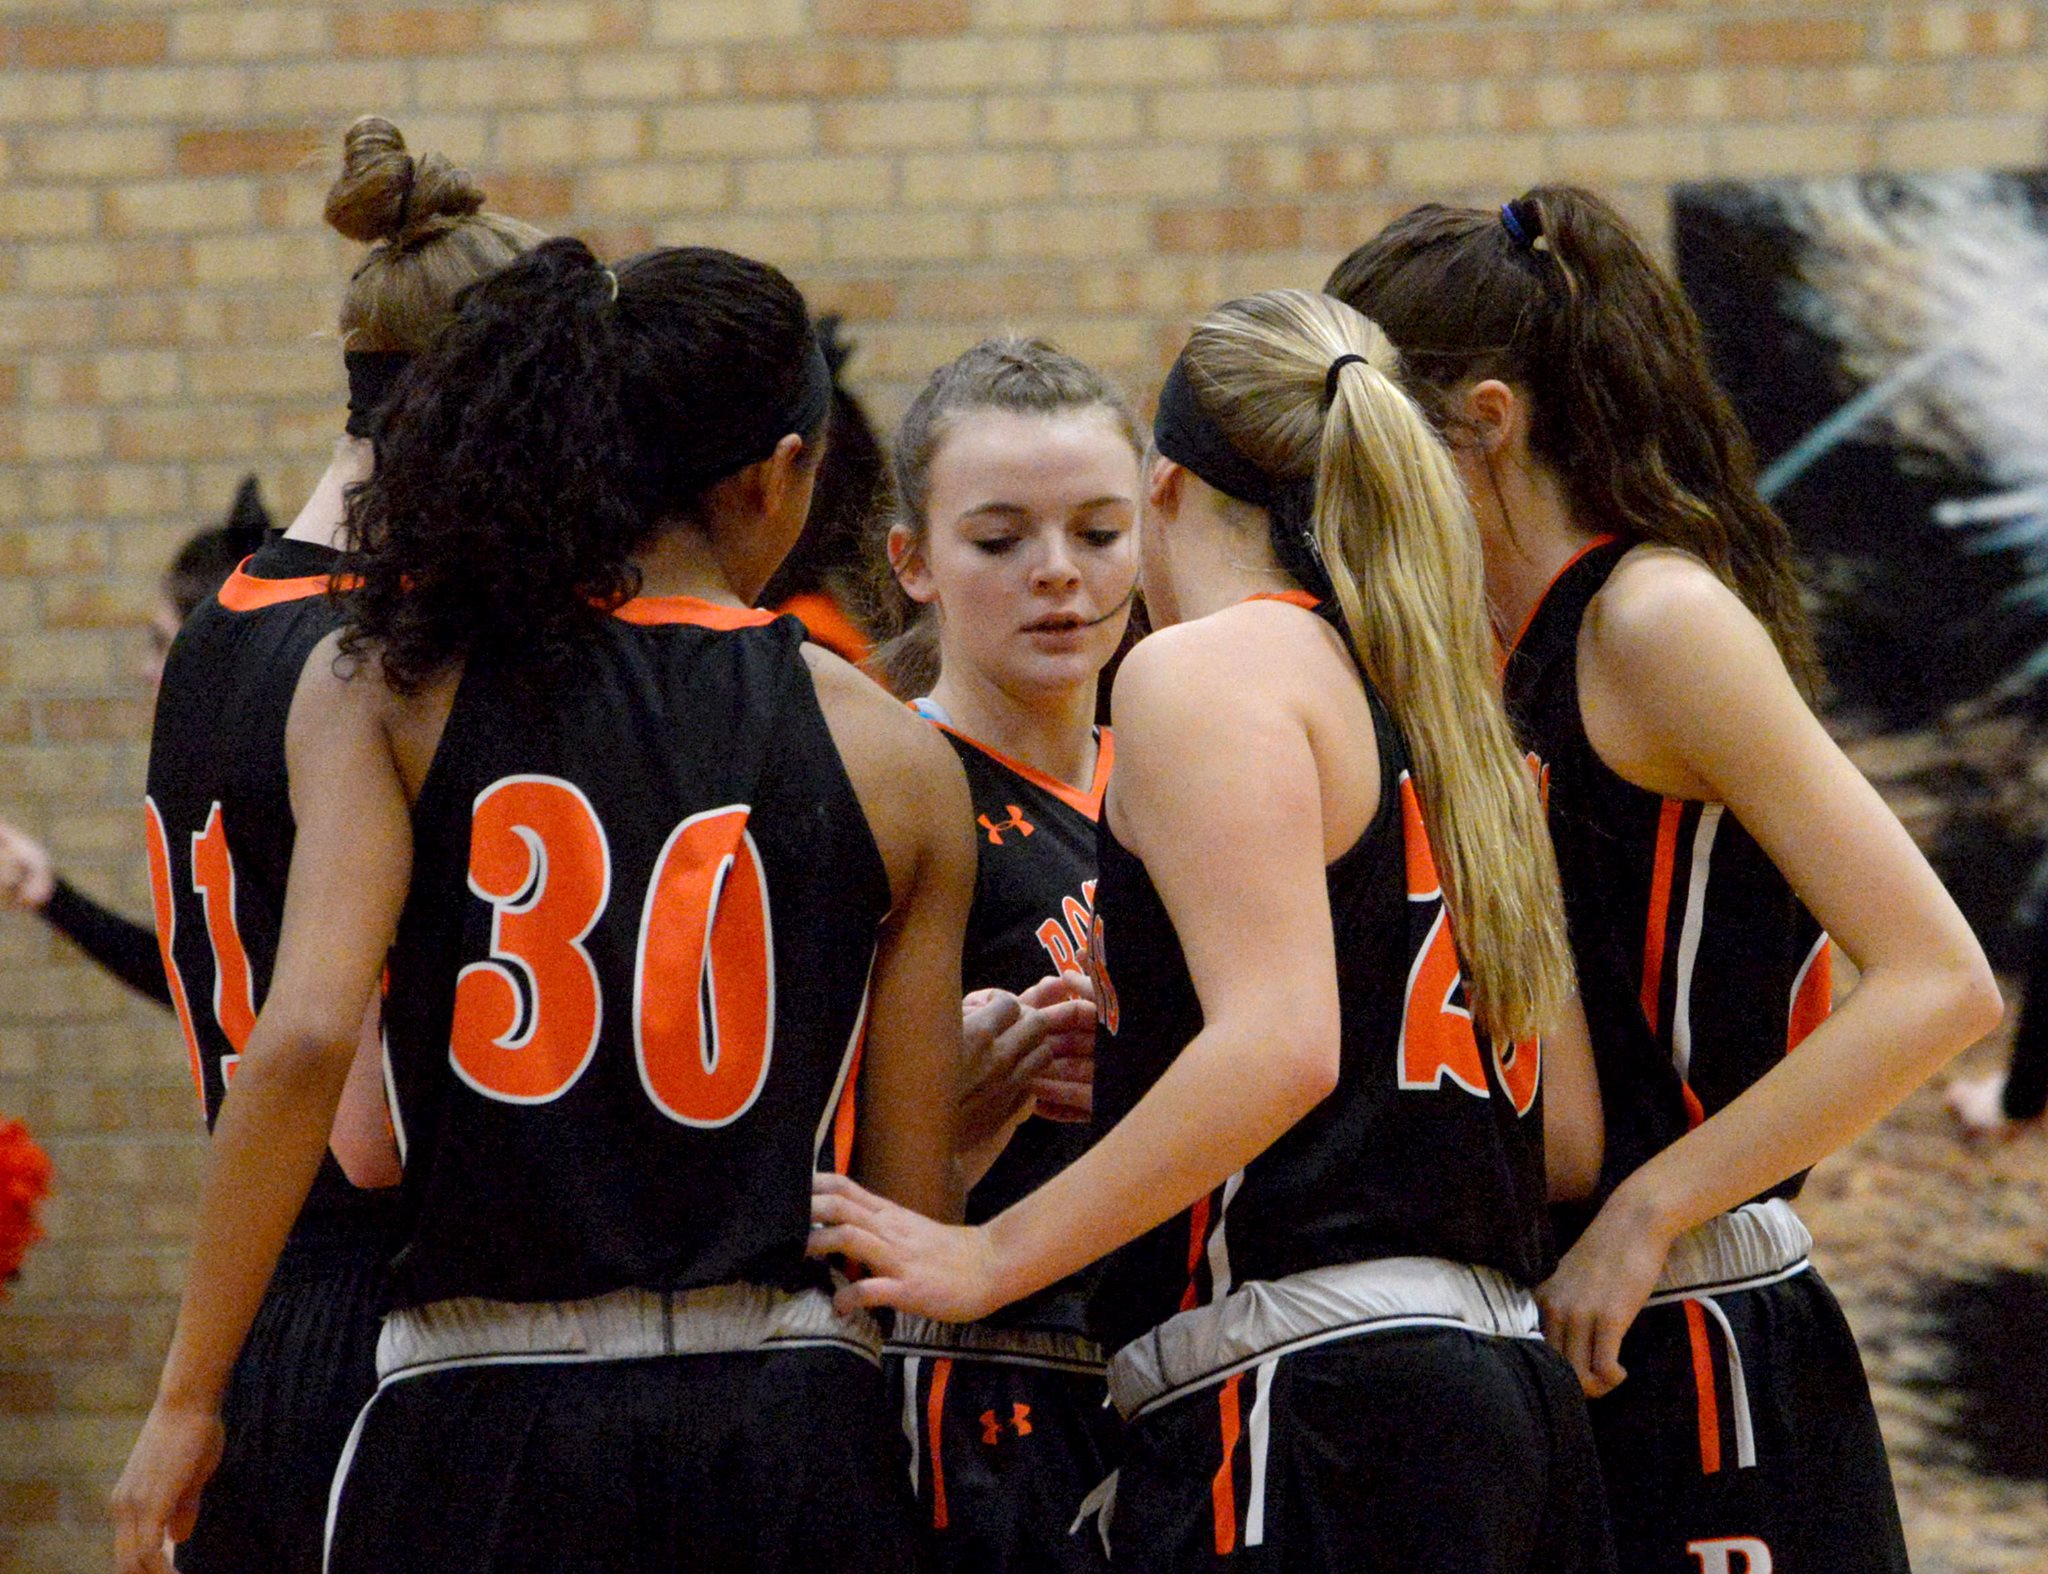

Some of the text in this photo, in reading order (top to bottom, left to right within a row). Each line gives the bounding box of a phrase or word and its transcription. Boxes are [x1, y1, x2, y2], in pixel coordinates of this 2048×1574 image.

[145, 795, 257, 1121] 1
[448, 773, 776, 1129] 30
[1397, 768, 1541, 1118] 2
